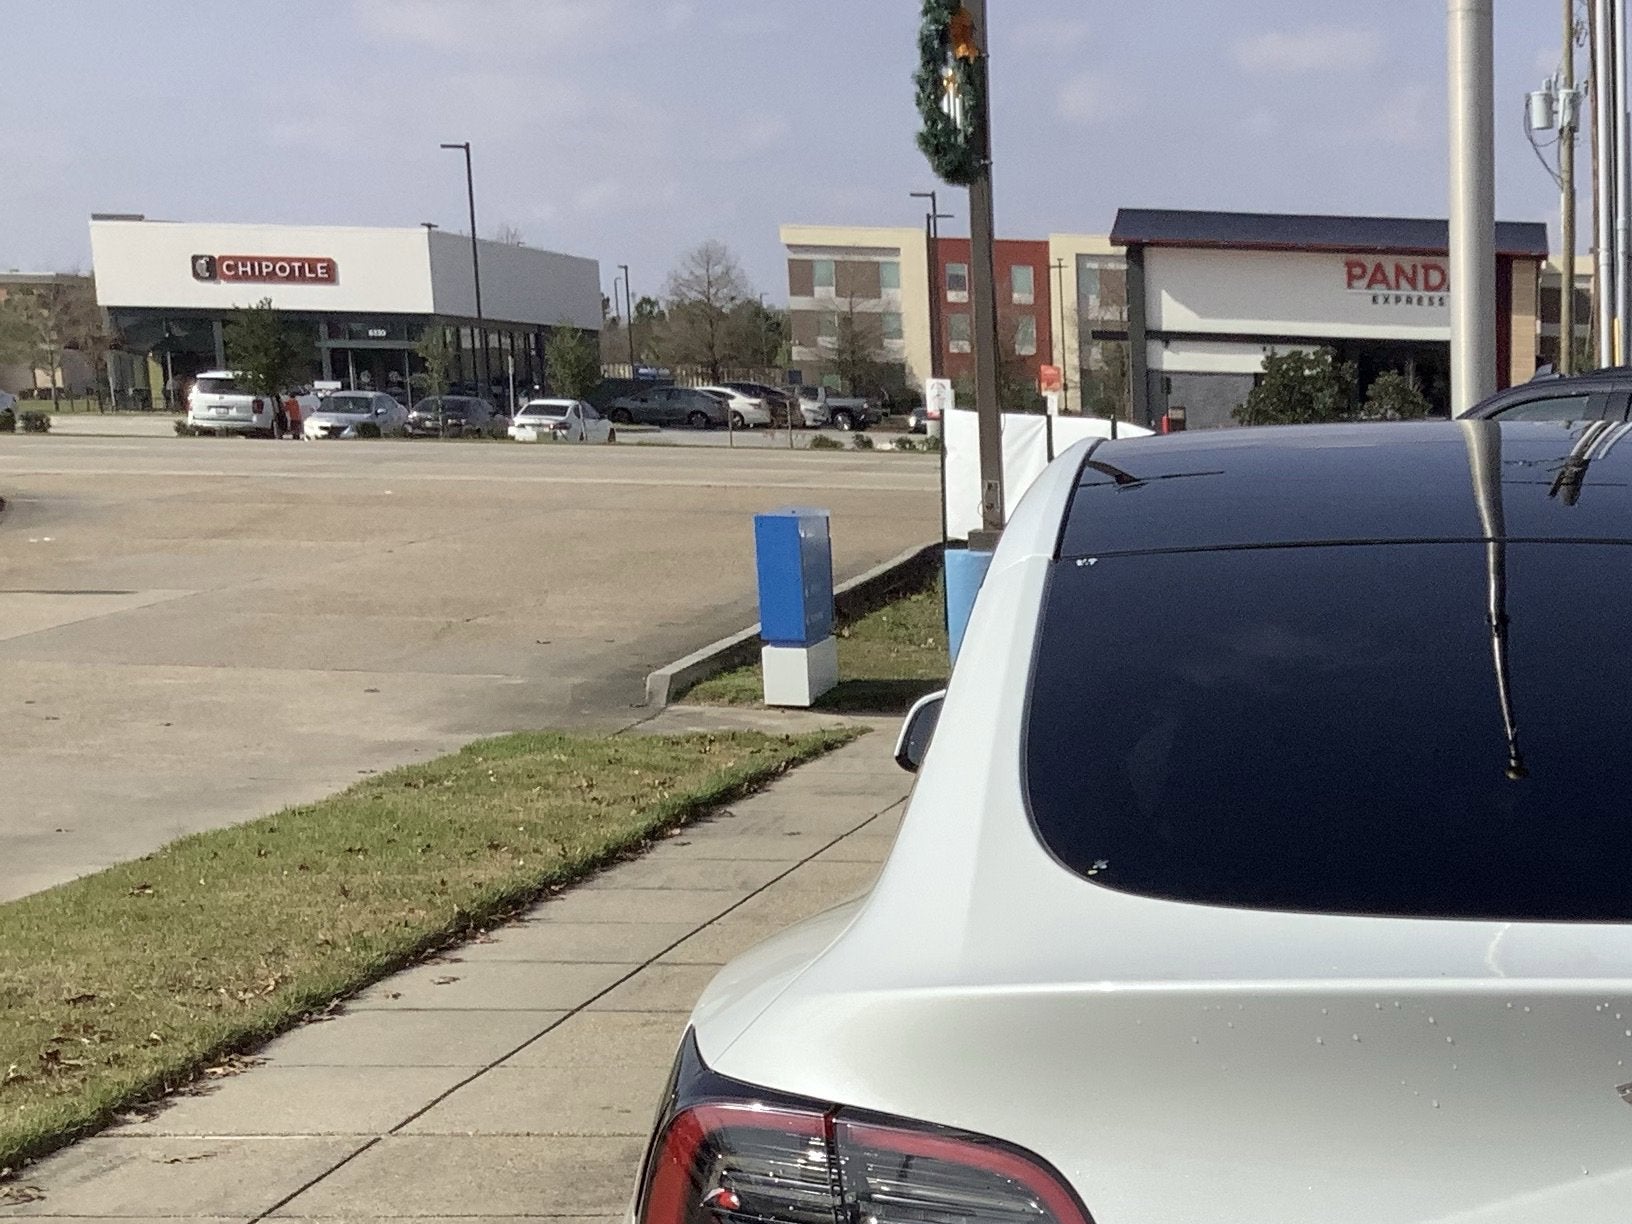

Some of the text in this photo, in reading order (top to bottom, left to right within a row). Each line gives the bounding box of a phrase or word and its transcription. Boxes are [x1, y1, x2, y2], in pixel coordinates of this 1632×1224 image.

[222, 260, 329, 278] CHIPOTLE
[1344, 259, 1450, 292] PAND
[1372, 295, 1445, 306] EXPRESS
